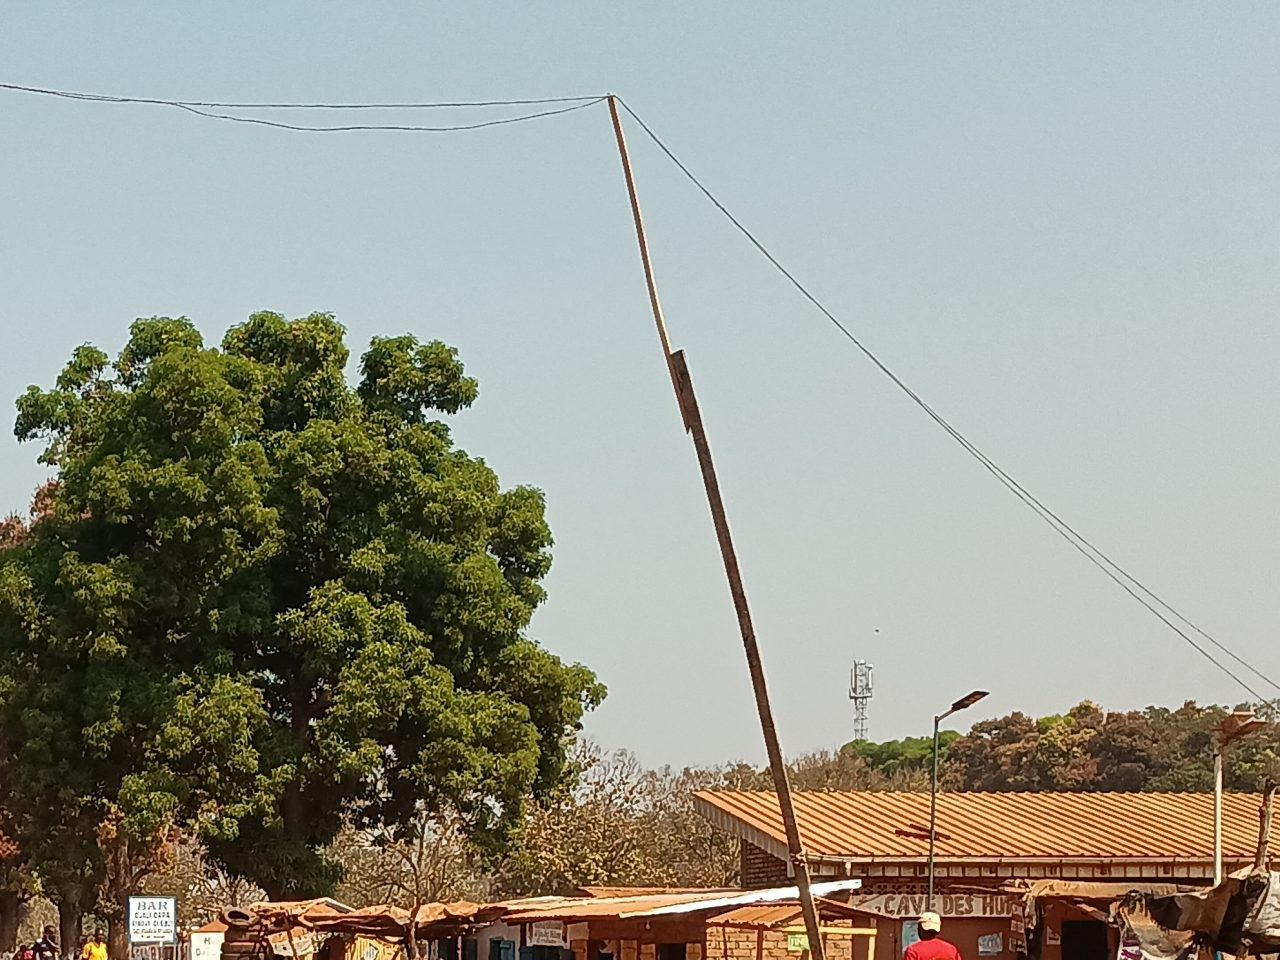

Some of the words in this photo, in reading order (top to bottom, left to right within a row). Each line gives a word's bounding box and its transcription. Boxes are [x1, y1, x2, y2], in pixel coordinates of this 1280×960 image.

[137, 901, 168, 911] BAR
[884, 895, 936, 915] CAVE
[942, 895, 974, 916] DES
